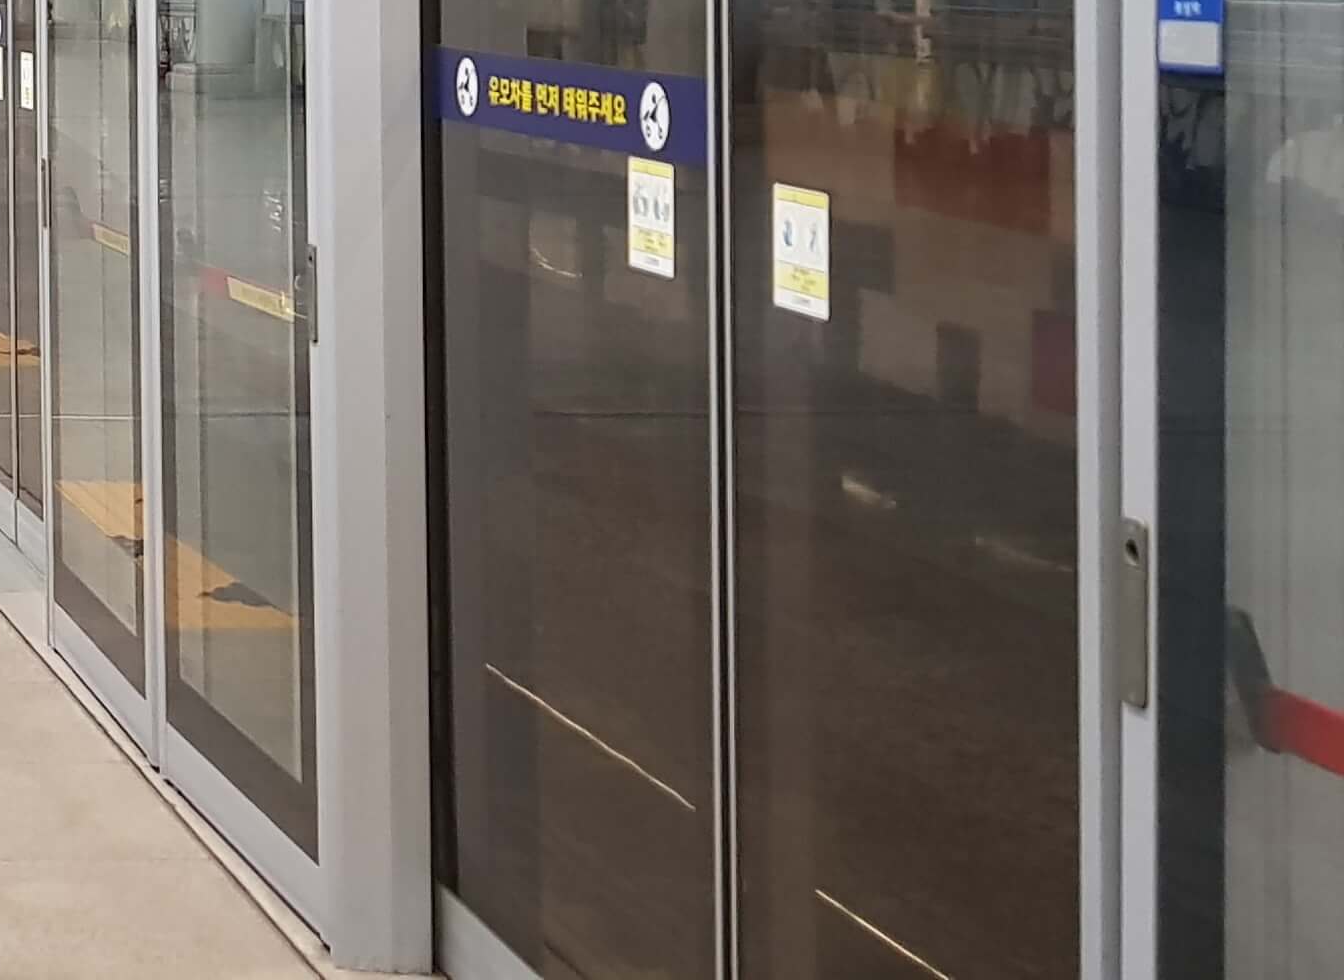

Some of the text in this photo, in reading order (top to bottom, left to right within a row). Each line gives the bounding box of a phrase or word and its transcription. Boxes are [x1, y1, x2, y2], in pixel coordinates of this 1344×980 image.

[488, 75, 628, 126] 유모차를 먼저 태워주세요
